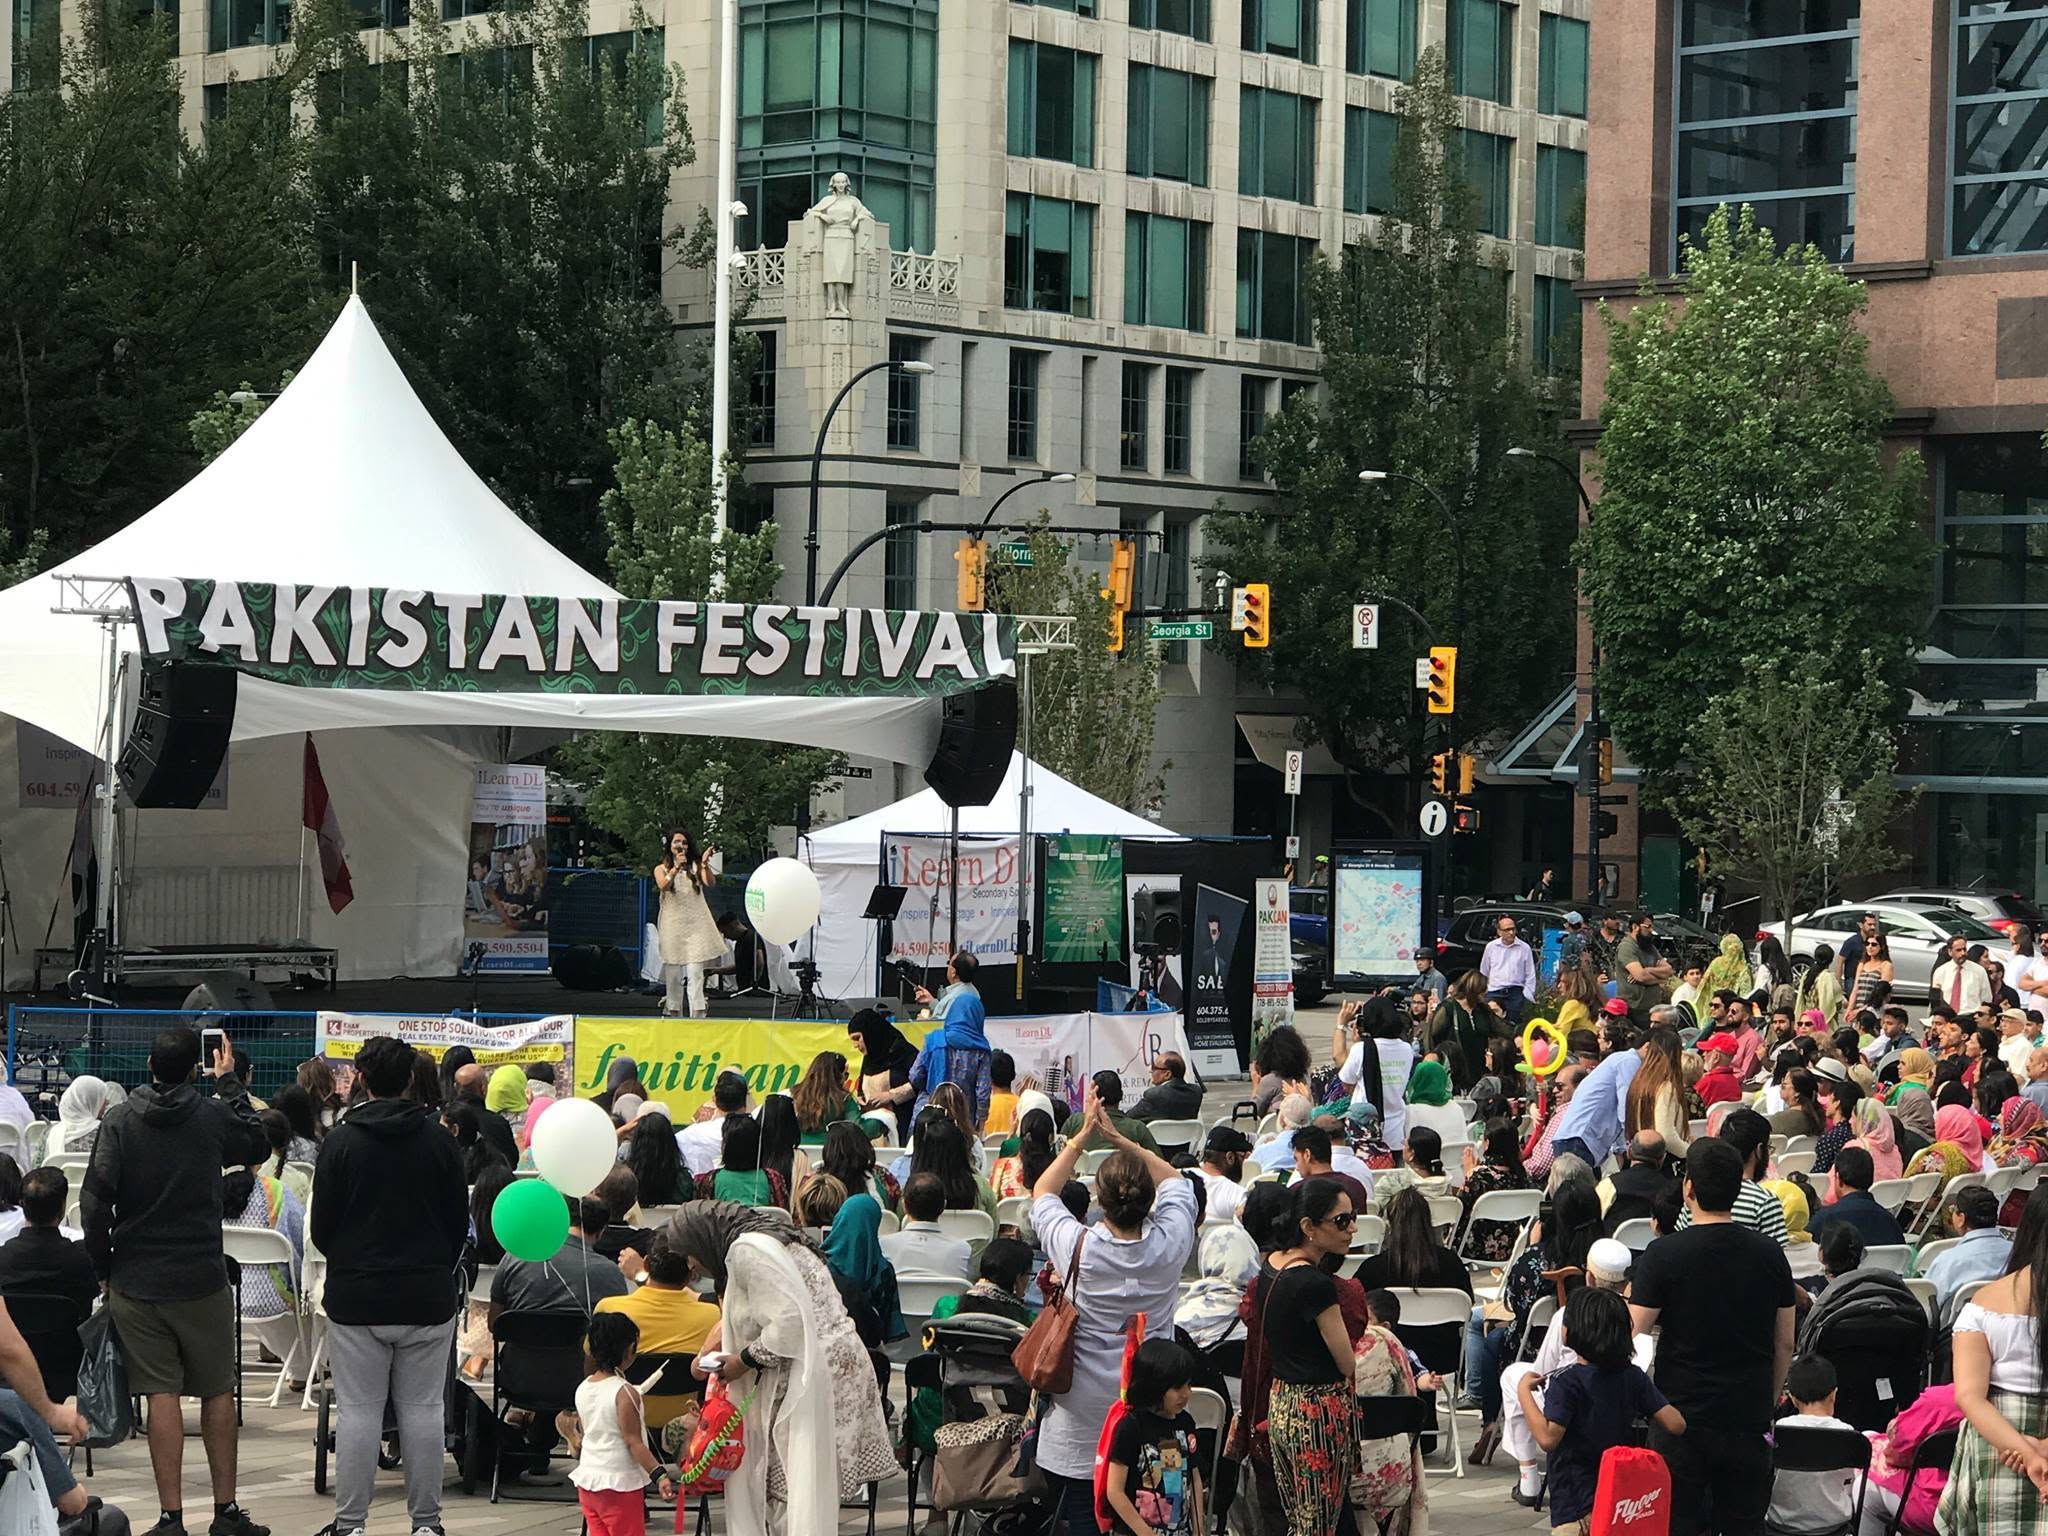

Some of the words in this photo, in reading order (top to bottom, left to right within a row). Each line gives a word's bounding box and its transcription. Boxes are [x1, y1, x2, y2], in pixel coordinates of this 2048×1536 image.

[1003, 545, 1036, 560] Horn
[129, 576, 619, 672] PAKISTAN
[658, 600, 1016, 678] FESTIVAL
[1152, 625, 1191, 639] Georgia
[1195, 624, 1207, 635] St
[45, 746, 81, 760] Inspir
[478, 770, 519, 785] iLearn
[523, 772, 543, 786] DL
[501, 803, 531, 813] unique
[889, 845, 984, 887] iLearn
[972, 887, 1007, 900] Secondary
[944, 907, 976, 920] Egage
[991, 905, 1018, 917] Innovat
[1259, 910, 1287, 924] PAKCAN
[966, 938, 1020, 954] iLearnDL.c
[398, 1020, 419, 1031] ONE
[421, 1020, 447, 1032] STOP
[497, 1030, 516, 1041] FOR
[398, 1032, 416, 1040] REAL
[449, 1035, 490, 1046] MORTGAGE
